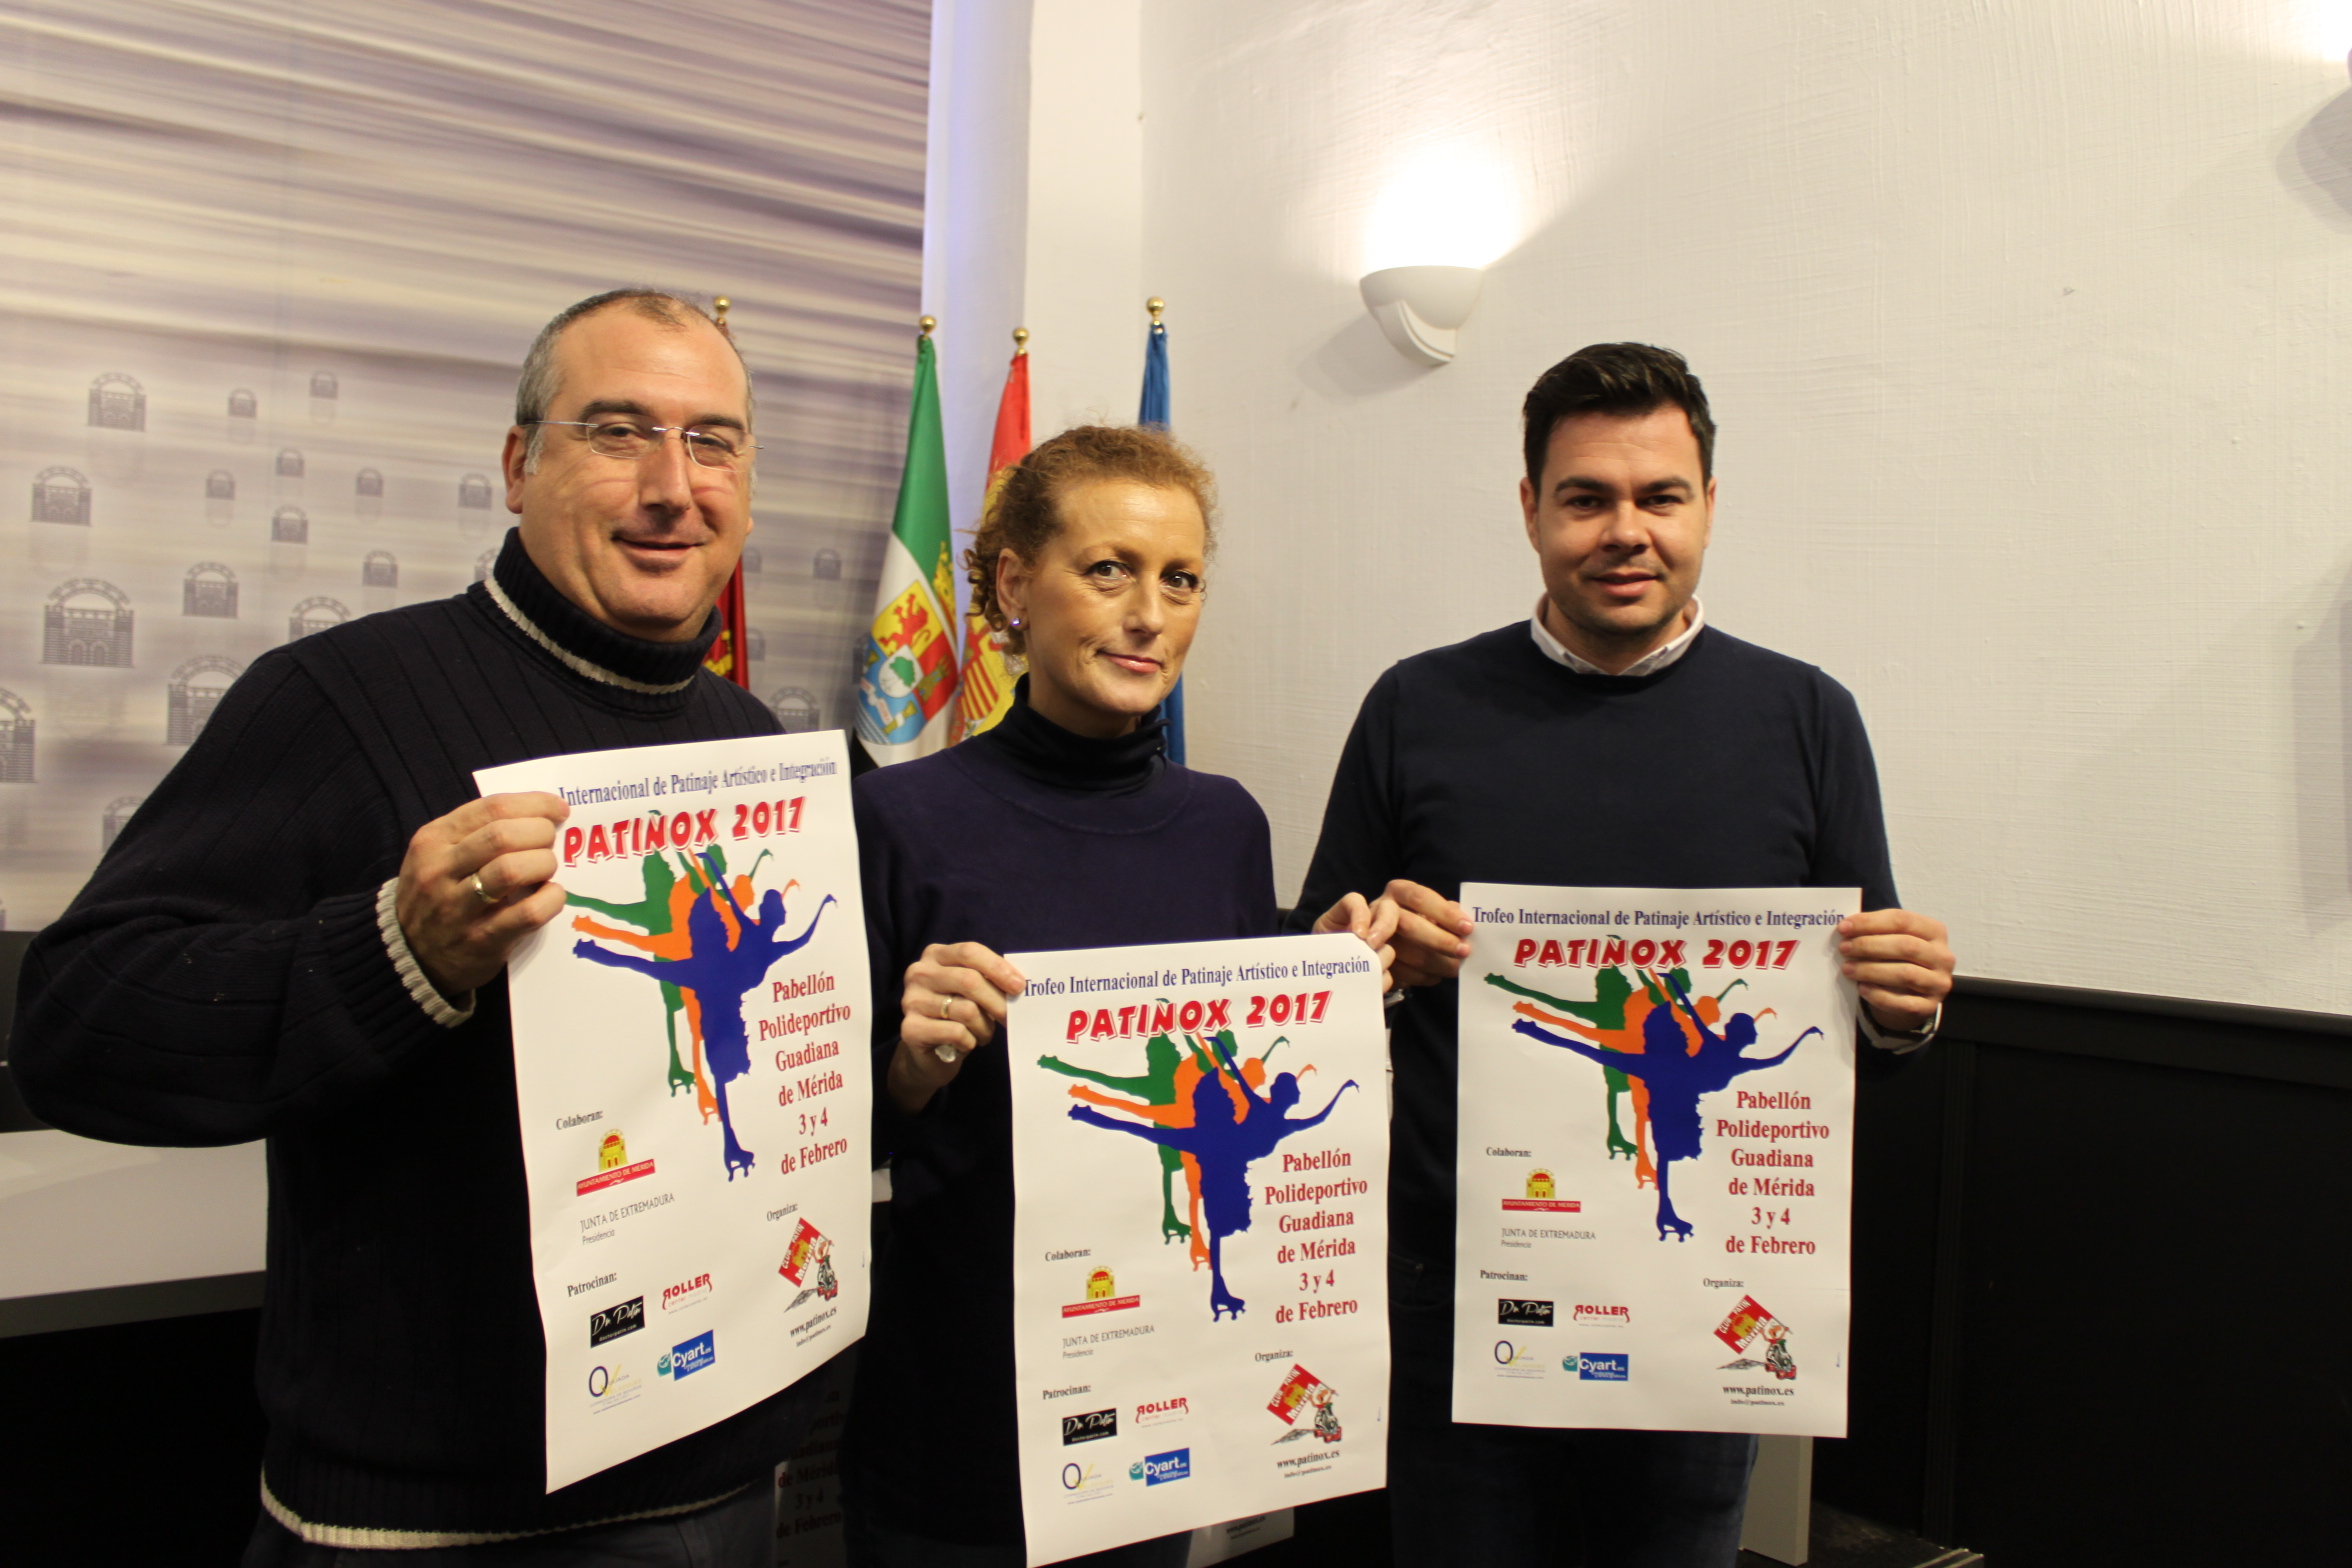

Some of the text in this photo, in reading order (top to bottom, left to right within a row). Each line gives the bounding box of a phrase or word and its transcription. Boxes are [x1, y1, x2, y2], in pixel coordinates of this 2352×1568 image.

[559, 757, 837, 807] Internacional de Patinaje Artístico e Integración
[732, 796, 807, 842] 2017
[1472, 906, 1844, 929] Trofeo Internacional de Patinaje Artístico e Integración
[1702, 938, 1800, 971] 2017
[772, 971, 835, 1003] Pabellón
[1024, 956, 1370, 997] Trofeo Internacional de Patinaje Artístico e Integración
[1246, 990, 1333, 1028] 2017
[759, 1003, 851, 1041] Polideportivo
[775, 1040, 839, 1072] Guadiana
[778, 1070, 843, 1107] de Mérida
[1736, 1091, 1811, 1110] Pabellón
[556, 1110, 603, 1130] Colaboran:
[799, 1107, 828, 1136] 3 y 4
[1716, 1119, 1829, 1143] Polideportivo
[781, 1138, 848, 1175] de Febrero
[1282, 1148, 1351, 1173] Pabellón
[1486, 1147, 1532, 1157] Colaboran:
[1731, 1148, 1813, 1167] Guadiana
[1264, 1177, 1367, 1205] Polideportivo
[1728, 1177, 1815, 1196] de Mérida
[580, 1193, 675, 1233] JUNTA DE EXTREMADURA
[767, 1203, 798, 1221] Organiza:
[1279, 1210, 1354, 1233] Guadiana
[1751, 1207, 1790, 1229] 3 y 4
[582, 1229, 615, 1245] Presidencia
[1501, 1228, 1596, 1240] JUNTA DE EXTREMADURA
[1725, 1235, 1816, 1254] de Febrero
[1045, 1249, 1091, 1262] Colaboran:
[1277, 1238, 1356, 1264] de Mérida
[567, 1272, 617, 1297] Patrocinan:
[1299, 1269, 1335, 1294] 3 y 4
[1480, 1270, 1528, 1282] Patrocinan:
[1703, 1278, 1744, 1289] Organiza:
[661, 1273, 713, 1310] ROLLER
[790, 1306, 837, 1337] www.patinox.es
[1276, 1299, 1358, 1324] de Febrero
[1573, 1305, 1630, 1323] ROLLER
[1062, 1325, 1155, 1349] JUNTA DE EXTREMADURA
[1255, 1350, 1293, 1363] Organiza:
[1042, 1385, 1091, 1400] Patrocinan:
[1722, 1385, 1794, 1397] www.patinox.es
[1135, 1397, 1189, 1423] ROLLER
[1277, 1450, 1340, 1469] www.patinox.es
